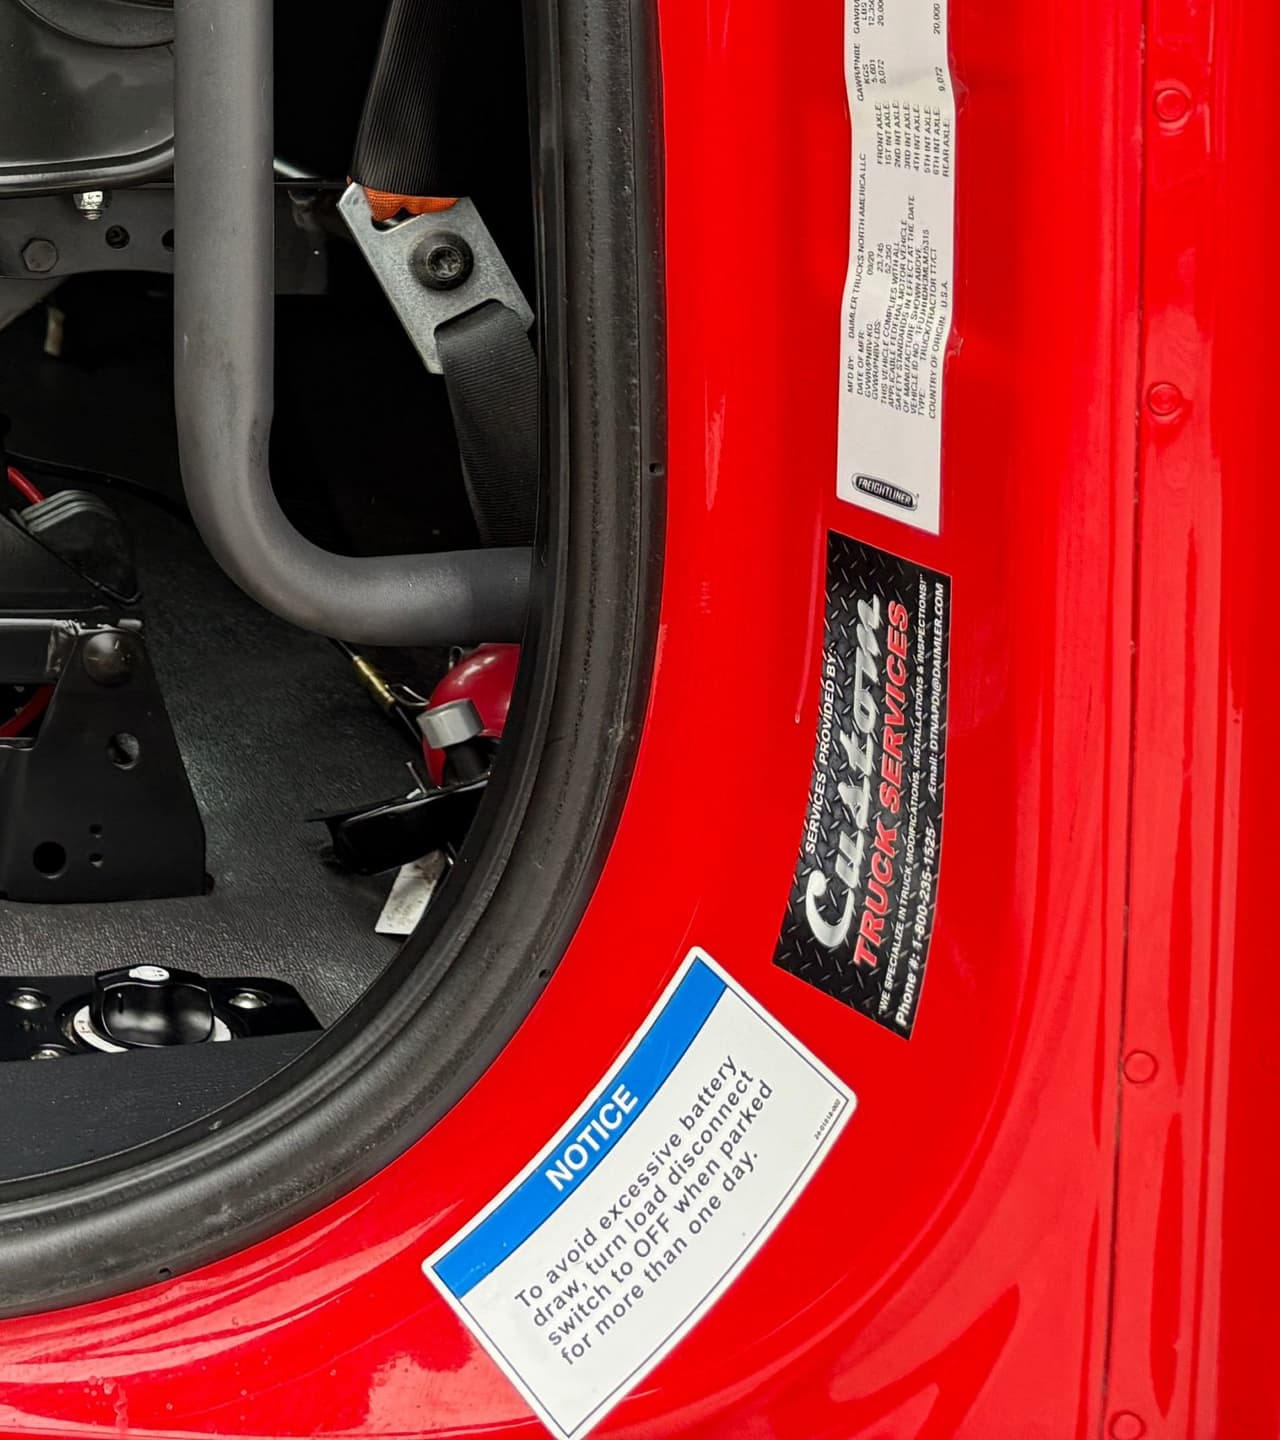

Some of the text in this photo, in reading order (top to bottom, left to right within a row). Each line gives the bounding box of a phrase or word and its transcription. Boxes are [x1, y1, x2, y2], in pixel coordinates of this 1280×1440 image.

[876, 131, 884, 165] FRONT
[852, 255, 864, 293] TRUCKS
[906, 259, 914, 296] EFFECT
[908, 245, 914, 257] AT
[848, 296, 858, 339] DAIMLER
[882, 287, 897, 337] COMPLIES
[890, 303, 902, 346] FEDERAL
[898, 263, 906, 299] MOTOR
[904, 300, 911, 309] IN
[920, 278, 936, 361] TRUCK/TRACTOR
[857, 355, 864, 368] OF
[896, 312, 909, 370] STANDARDS
[903, 283, 921, 413] OF MANUFACTURE SHOWN
[912, 360, 918, 370] ID
[910, 372, 918, 414] VEHICLE
[928, 355, 937, 420] COUNTRY OF
[855, 476, 913, 507] FREIGHTLINER
[928, 582, 944, 794] Email: DTNAPDI@DAIMLER.COM
[913, 685, 925, 768] INSTALLATIONS
[805, 680, 836, 855] SERVICES PROVIDED
[806, 594, 881, 948] Custom
[853, 599, 910, 968] TRUCK SERVICES
[901, 867, 912, 906] TRUCK
[901, 905, 908, 921] IN
[883, 920, 905, 990] SPECIALIZE
[895, 973, 918, 1026] Phone
[912, 826, 937, 949] 1-800-235-1525
[544, 1083, 639, 1192] NOTICE
[514, 1055, 739, 1309] To avoid excessive battery
[532, 1069, 756, 1328] draw, turn load disconnect
[547, 1081, 774, 1346] switch to OFF when parked
[561, 1151, 759, 1365] for more than one day.
